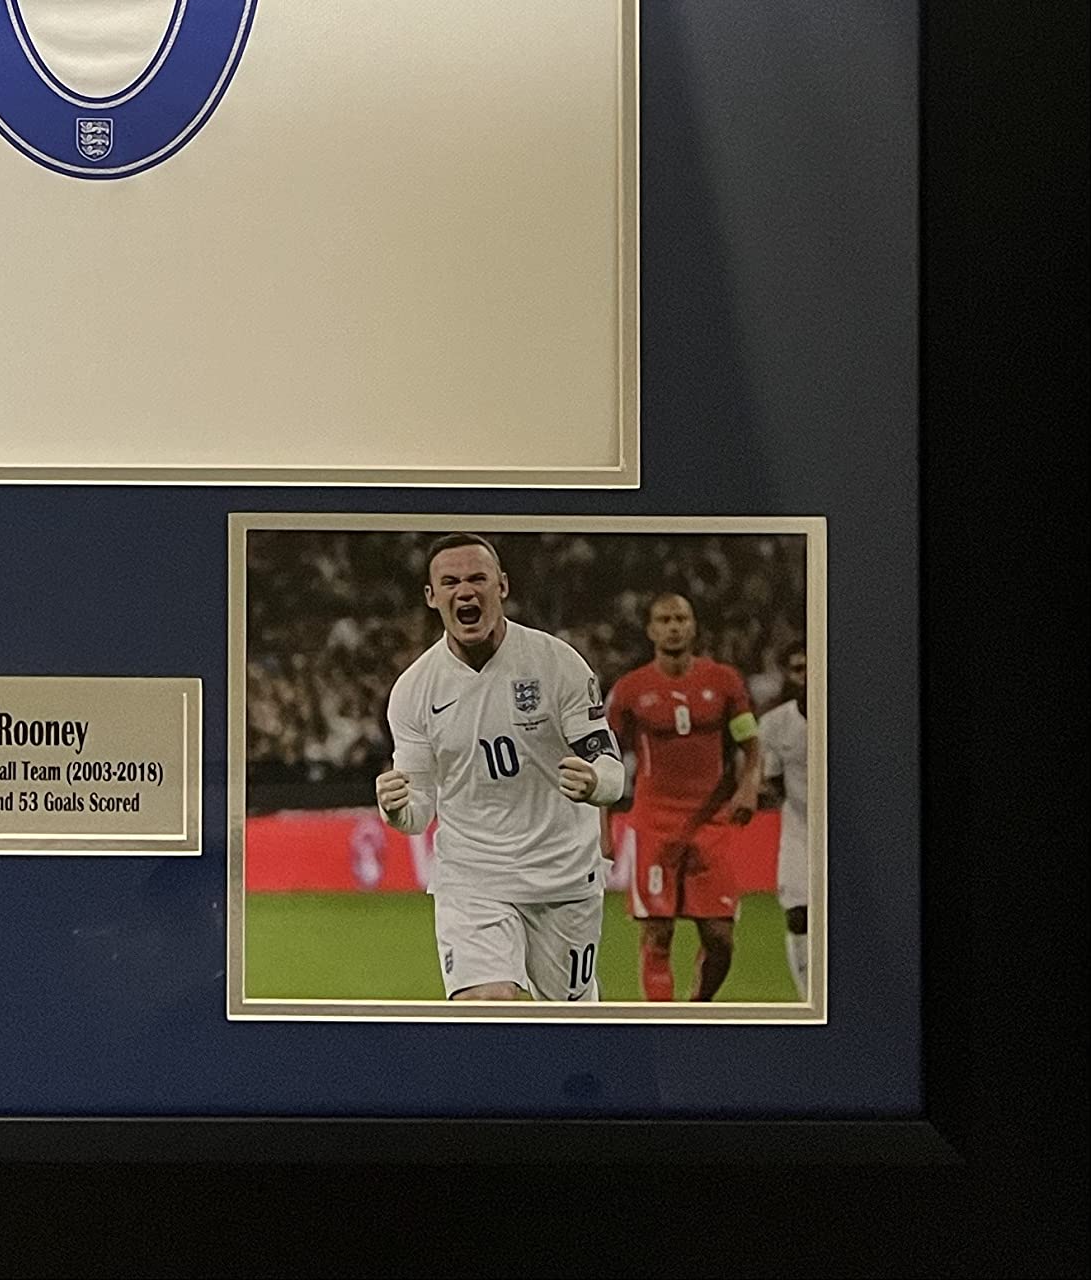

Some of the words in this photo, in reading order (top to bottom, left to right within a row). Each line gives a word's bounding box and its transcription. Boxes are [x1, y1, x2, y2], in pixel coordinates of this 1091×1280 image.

[21, 761, 61, 781] Team
[66, 761, 164, 787] (2003-2018)
[478, 735, 520, 780] 10
[18, 792, 38, 812] 53
[43, 792, 85, 812] Goals
[89, 792, 140, 813] Scored
[569, 943, 595, 989] 10
